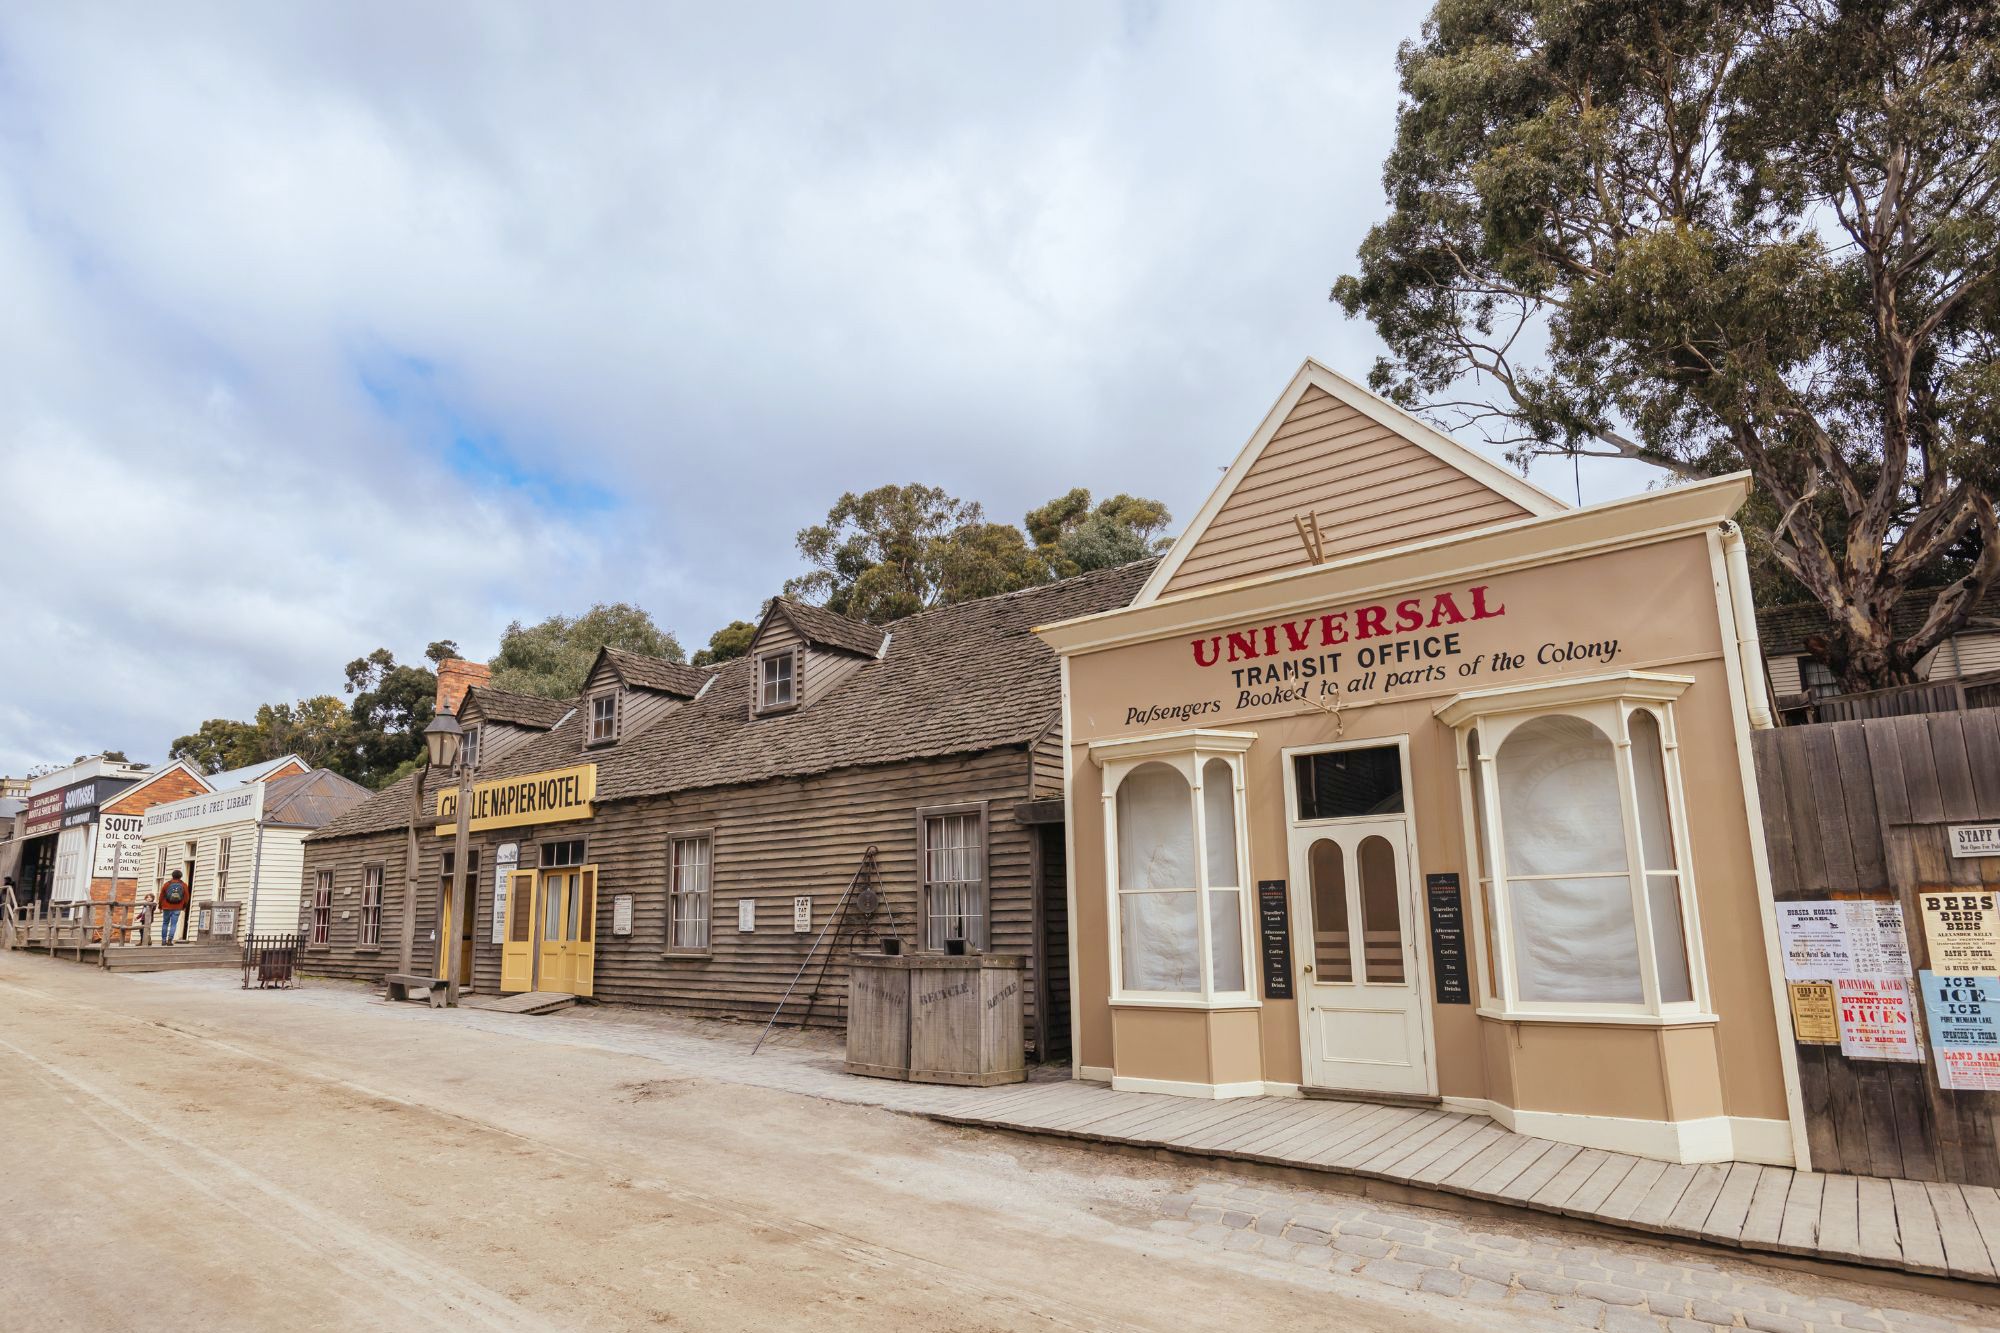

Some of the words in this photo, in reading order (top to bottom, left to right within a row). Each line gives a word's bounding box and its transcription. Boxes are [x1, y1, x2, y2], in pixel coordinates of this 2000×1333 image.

[1191, 586, 1505, 667] UNIVERSAL
[1232, 653, 1342, 688] TRANSIT
[1358, 633, 1461, 667] OFFICE
[1236, 681, 1309, 710] Booked
[1320, 680, 1339, 696] to
[1347, 671, 1376, 693] all
[1384, 665, 1446, 692] parts
[1459, 655, 1484, 677] of
[1491, 652, 1525, 672] the
[1537, 639, 1622, 664] Colony.
[65, 784, 95, 810] SOUTHSEA
[442, 790, 488, 819] CHLIE
[491, 782, 536, 817] NAPIER
[538, 775, 586, 810] HOTEL.
[174, 806, 200, 820] INSTITUTE
[209, 801, 224, 813] FREE
[227, 794, 253, 810] LIBRARY
[1958, 830, 1992, 842] STAFF
[1926, 896, 1993, 910] BEES
[1940, 912, 1982, 921] BEES
[1944, 978, 1975, 987] ICE
[920, 983, 968, 1006] RECYCLE
[1940, 990, 1986, 1001] ICE
[1949, 1004, 1981, 1014] ICE
[1844, 1010, 1907, 1023] RACES
[1942, 1031, 1974, 1039] SPENCER'S
[1977, 1032, 1997, 1040] STORE
[1944, 1052, 1972, 1060] LAND
